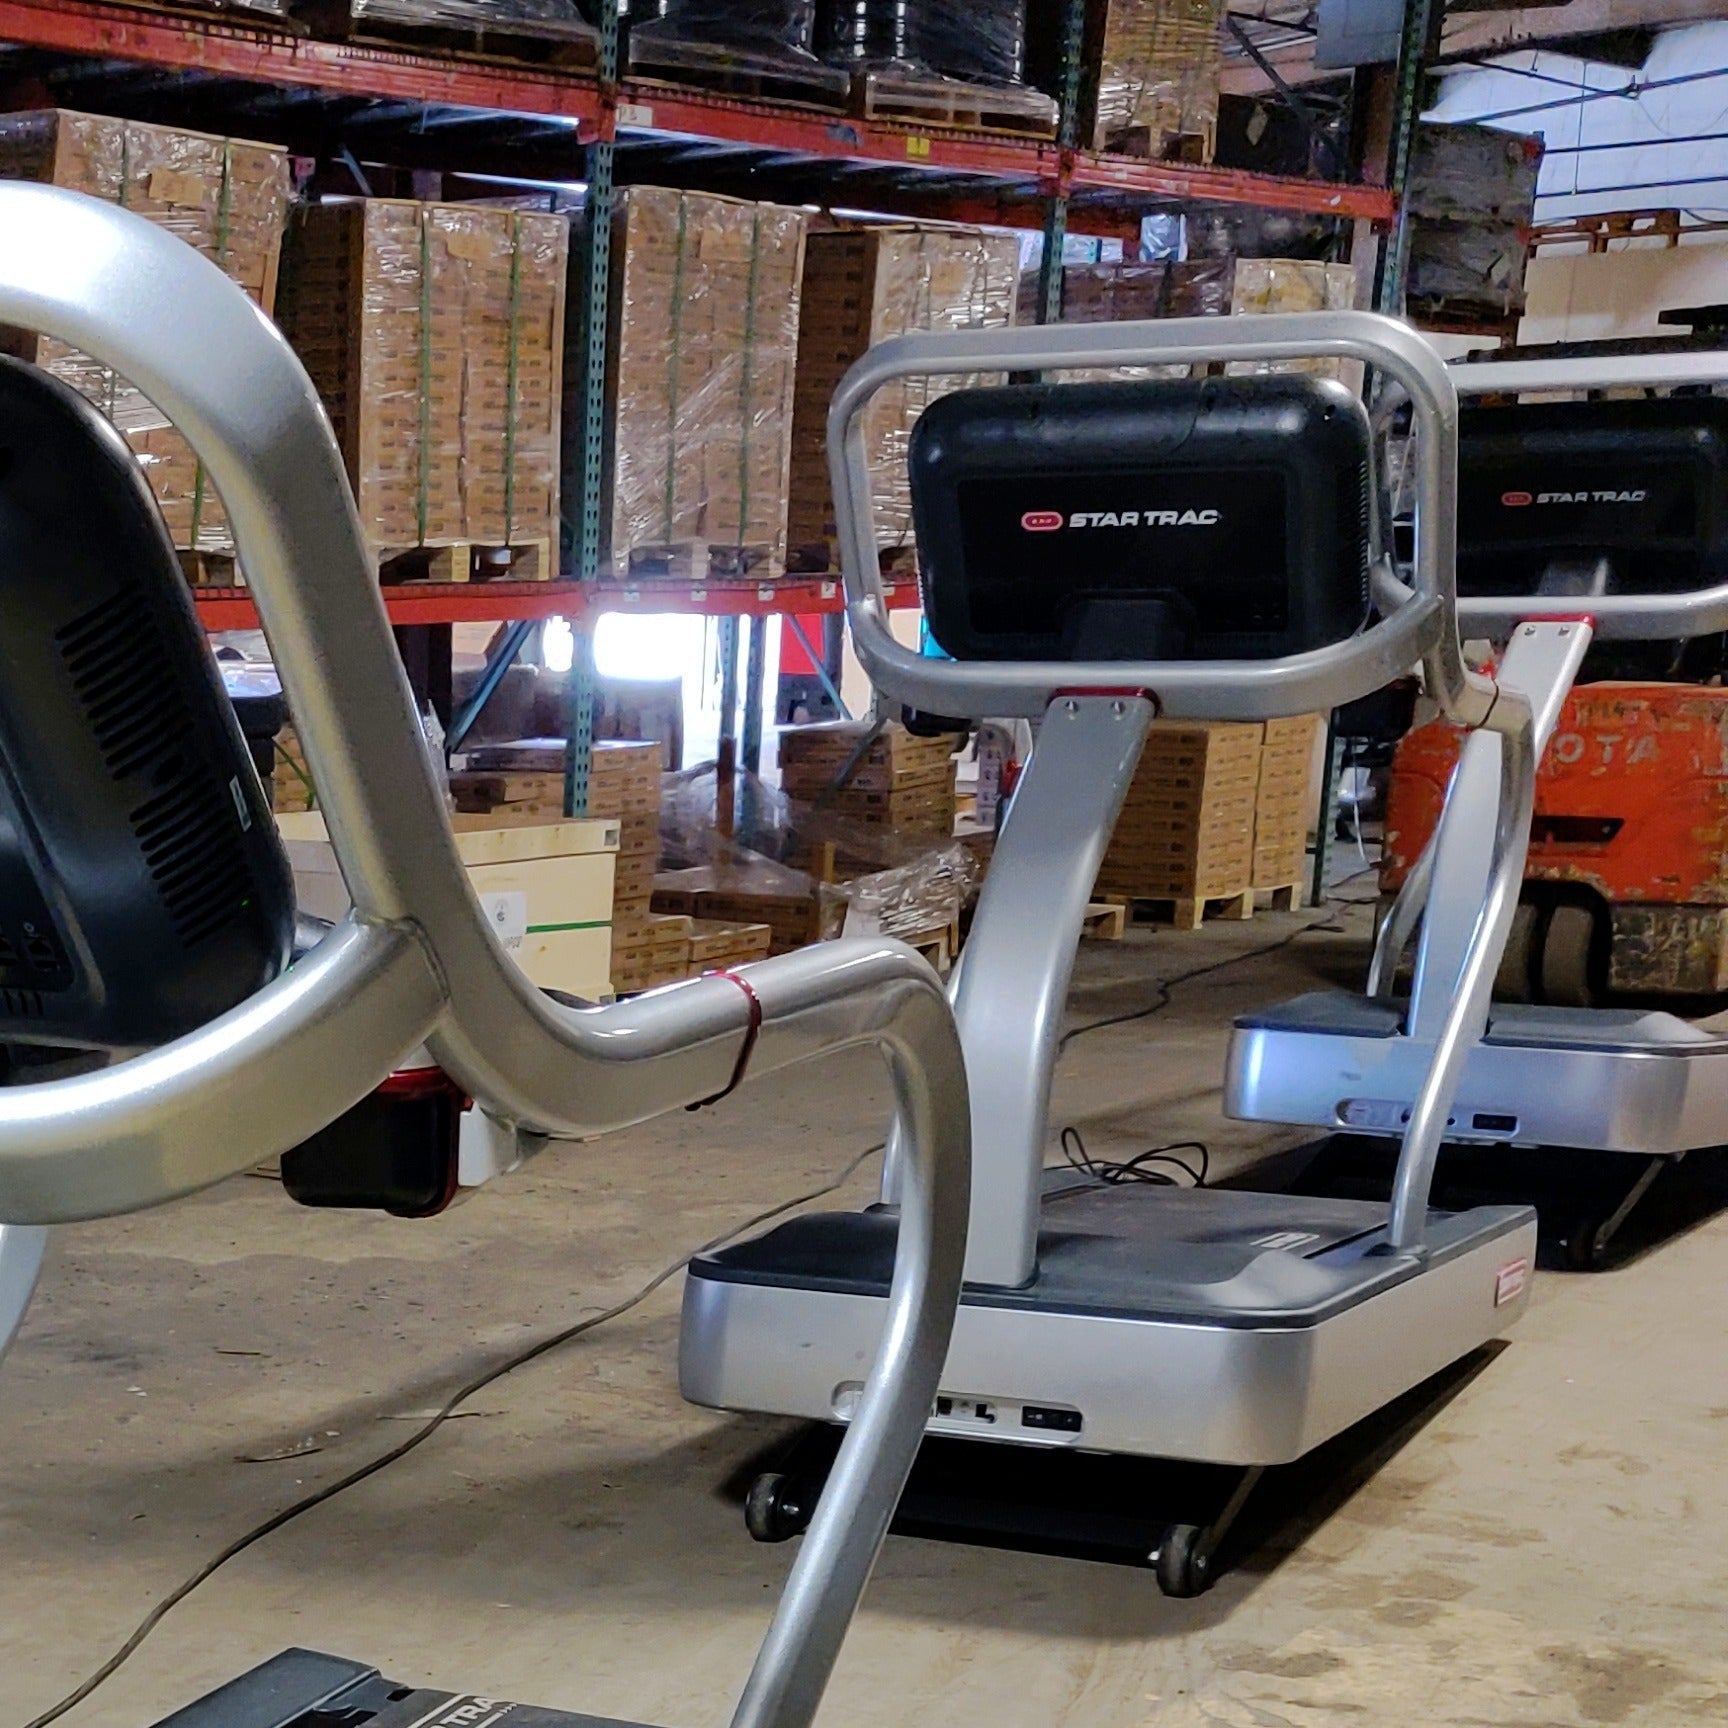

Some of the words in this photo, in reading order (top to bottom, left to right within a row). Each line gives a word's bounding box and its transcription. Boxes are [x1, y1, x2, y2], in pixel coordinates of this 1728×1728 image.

[1536, 491, 1588, 504] STAR
[1592, 490, 1646, 502] TRAC
[1069, 511, 1140, 528] STAR
[1144, 508, 1219, 526] TRAC
[440, 1697, 503, 1727] TRA
